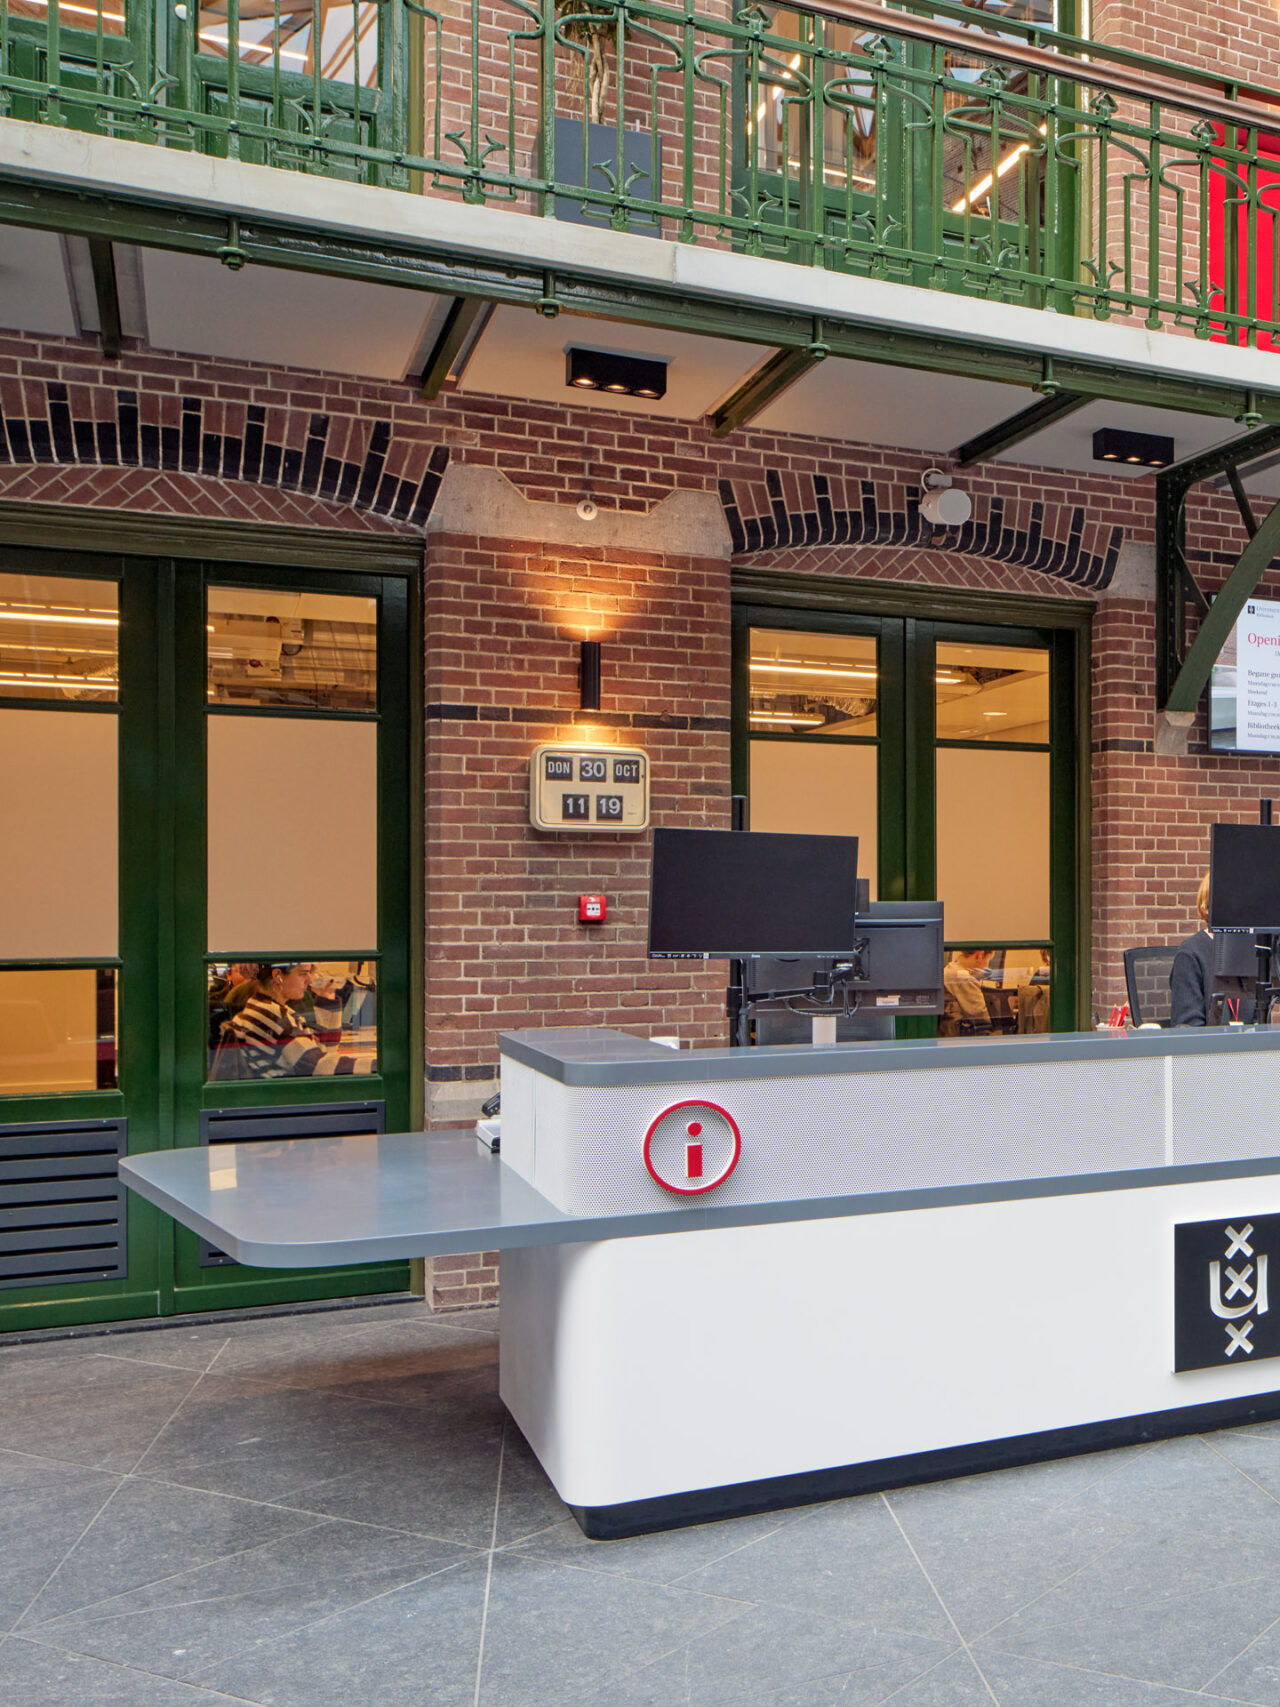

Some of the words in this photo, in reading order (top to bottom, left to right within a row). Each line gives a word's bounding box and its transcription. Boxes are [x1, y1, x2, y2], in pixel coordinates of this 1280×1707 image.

[1247, 669, 1270, 680] Begane
[547, 761, 571, 774] DON
[580, 761, 606, 778] 30
[615, 764, 639, 777] OCT
[566, 798, 586, 815] 11
[599, 798, 621, 815] 19
